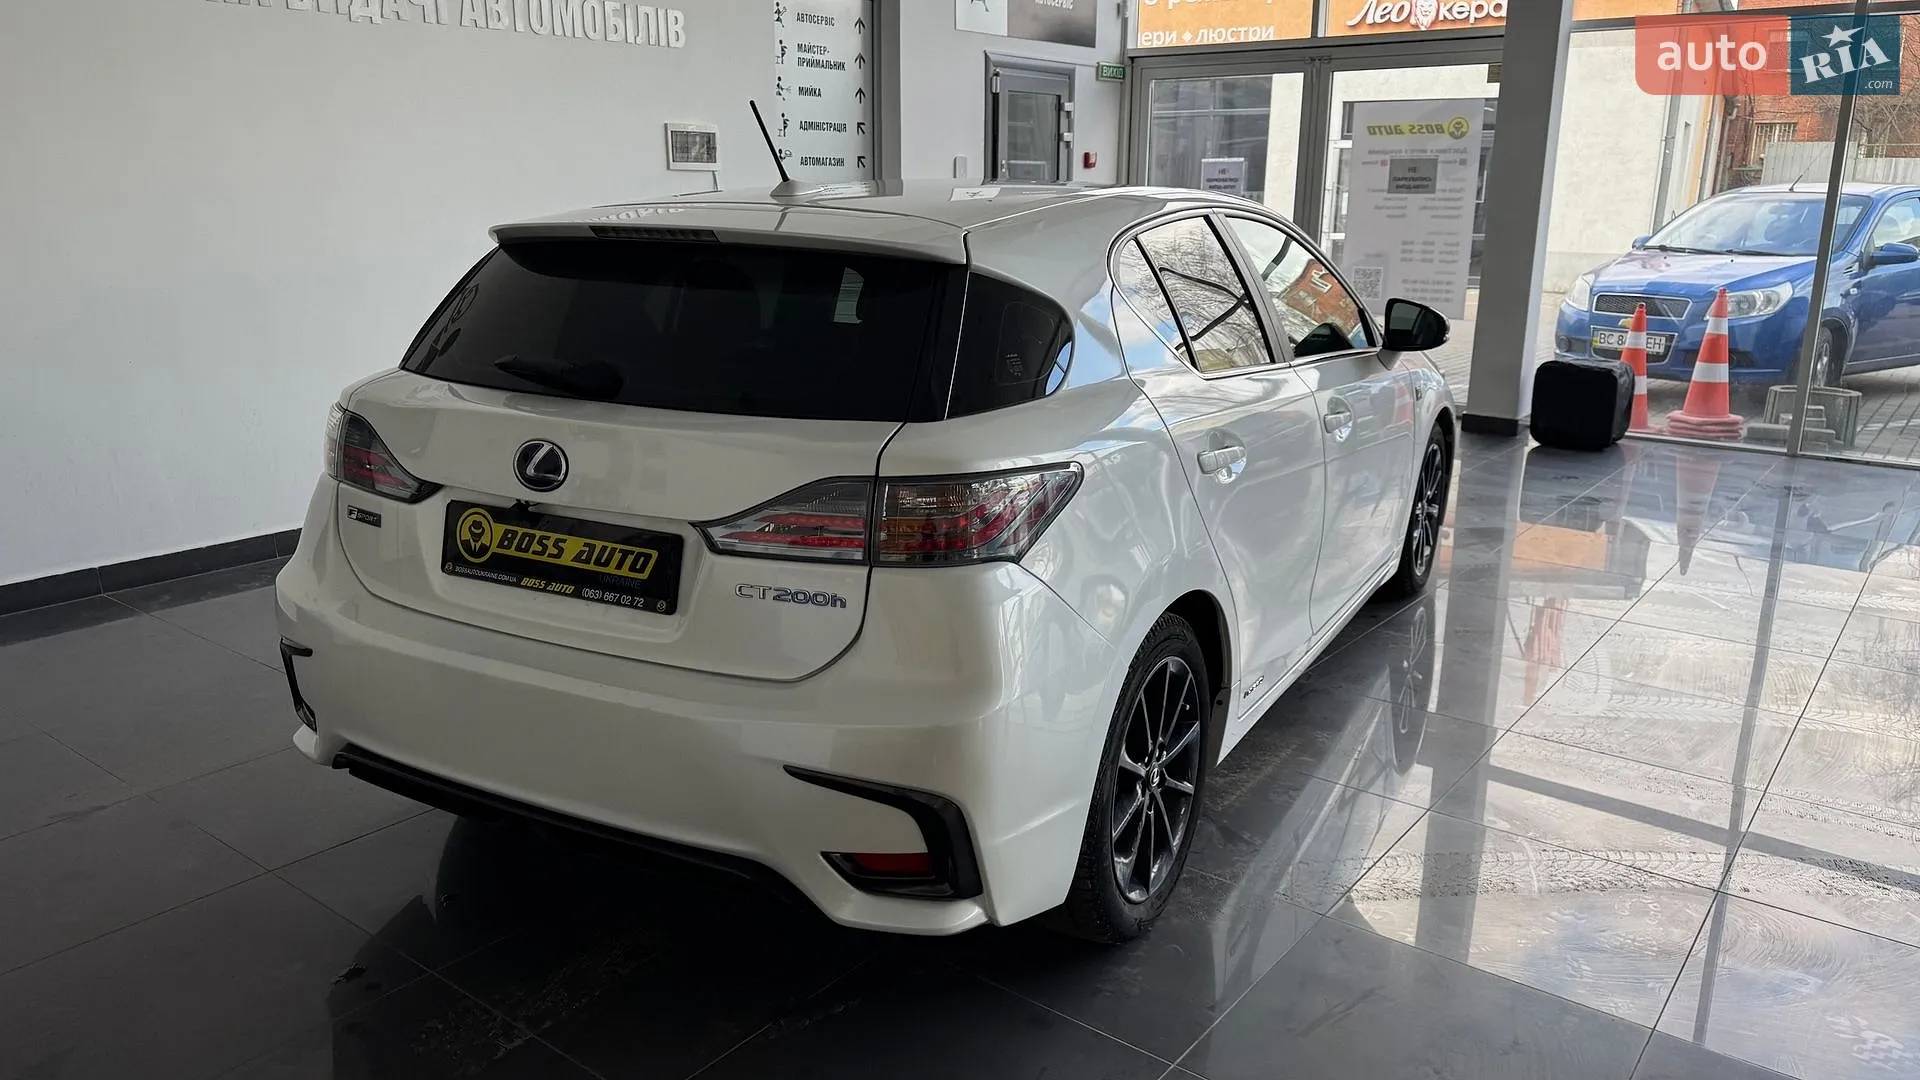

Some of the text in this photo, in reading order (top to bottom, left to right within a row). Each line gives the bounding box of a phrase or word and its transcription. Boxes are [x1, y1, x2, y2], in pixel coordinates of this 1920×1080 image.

[460, 0, 687, 49] АВТОМОБІЛІВ
[796, 12, 836, 27] АВТОСЕРВІС
[1196, 25, 1276, 43] люстри
[797, 42, 830, 56] МАЙСТЕР-
[797, 56, 846, 72] ПРИЙМАЛЬНИК
[798, 85, 822, 98] МИЙКА
[799, 121, 847, 133] АДМІНІСТРАЦІЯ
[800, 156, 845, 168] АВТОМАГАЗИН
[496, 528, 654, 574] BOSS AUTO
[520, 577, 546, 590] BOSS
[547, 582, 576, 594] AUTO
[582, 587, 602, 600] (063)
[603, 592, 620, 602] 667
[620, 595, 632, 605] 02
[633, 598, 645, 608] 72
[735, 583, 847, 609] CT200h
